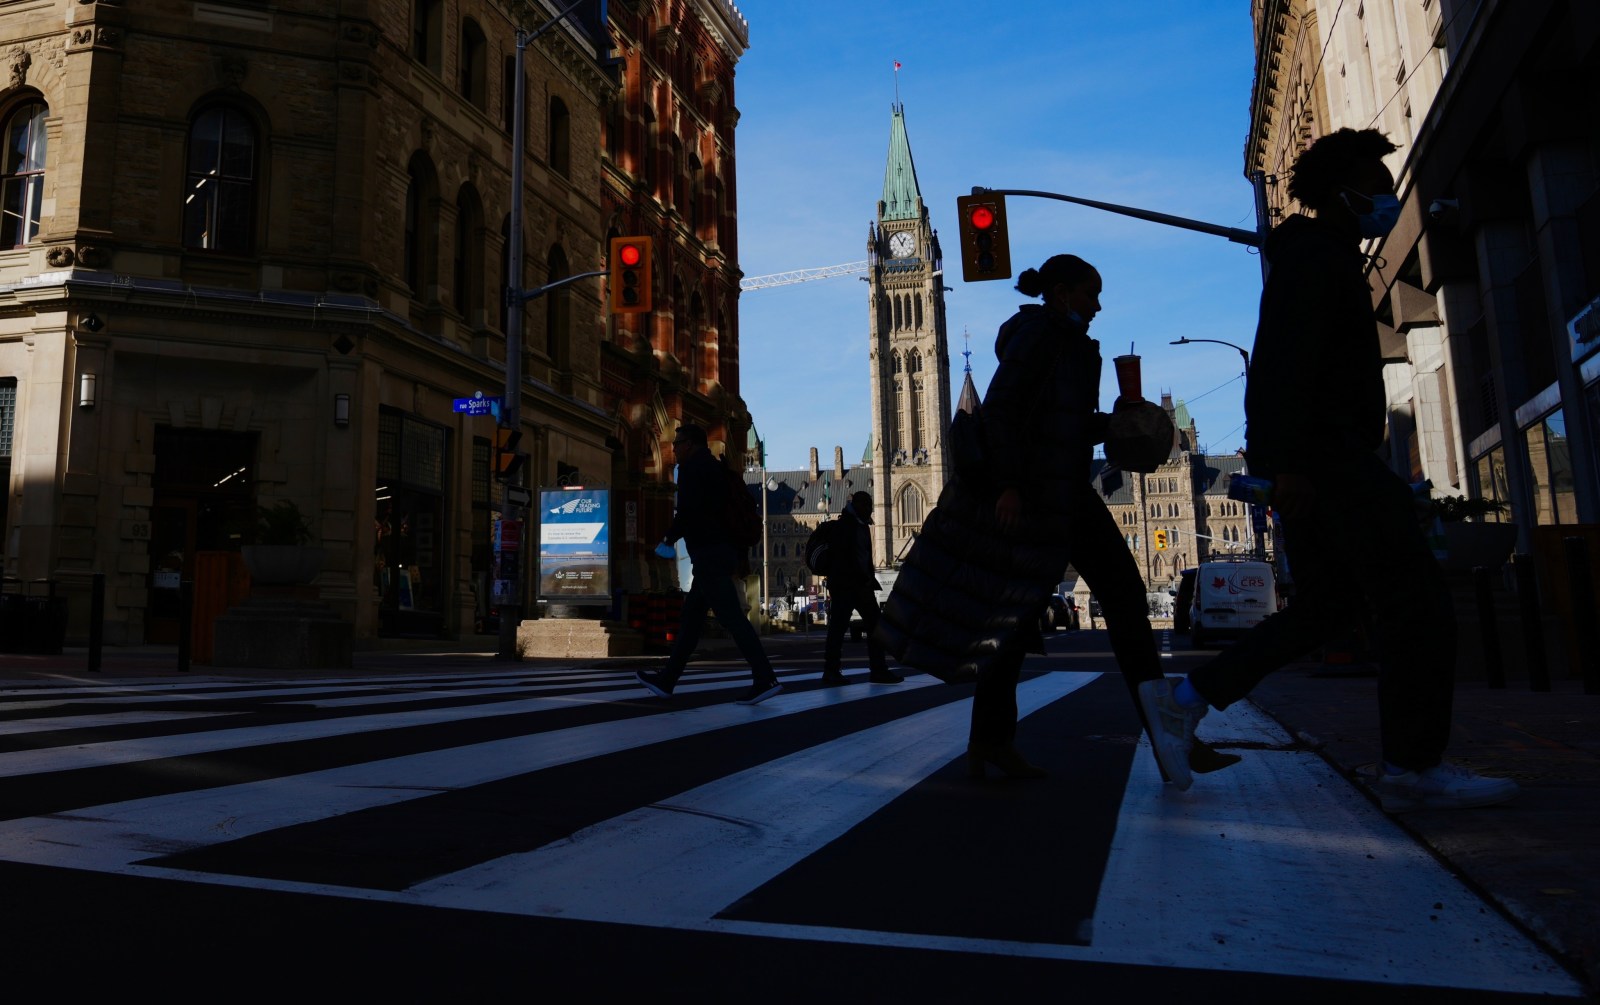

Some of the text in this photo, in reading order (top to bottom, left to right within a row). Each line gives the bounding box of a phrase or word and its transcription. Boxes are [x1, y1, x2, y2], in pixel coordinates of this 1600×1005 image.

[468, 398, 490, 410] Sparks
[132, 524, 148, 537] 93
[1240, 579, 1265, 587] CRS
